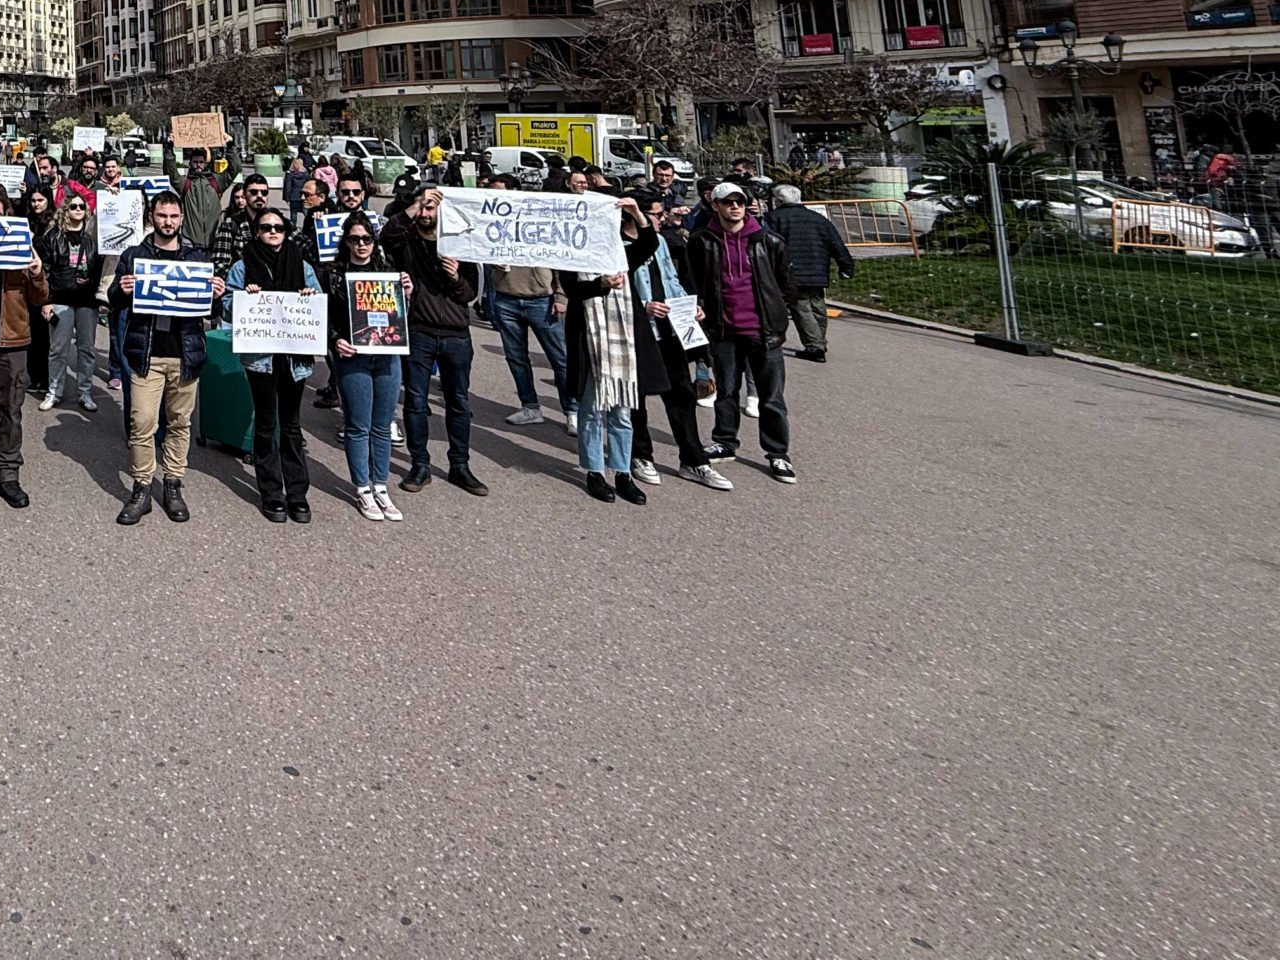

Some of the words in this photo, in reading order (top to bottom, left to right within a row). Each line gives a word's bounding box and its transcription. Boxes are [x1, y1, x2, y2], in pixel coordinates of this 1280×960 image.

[355, 281, 382, 294] ΟΛΗ
[258, 294, 284, 304] ΔΕΝ
[284, 306, 312, 315] TENGO
